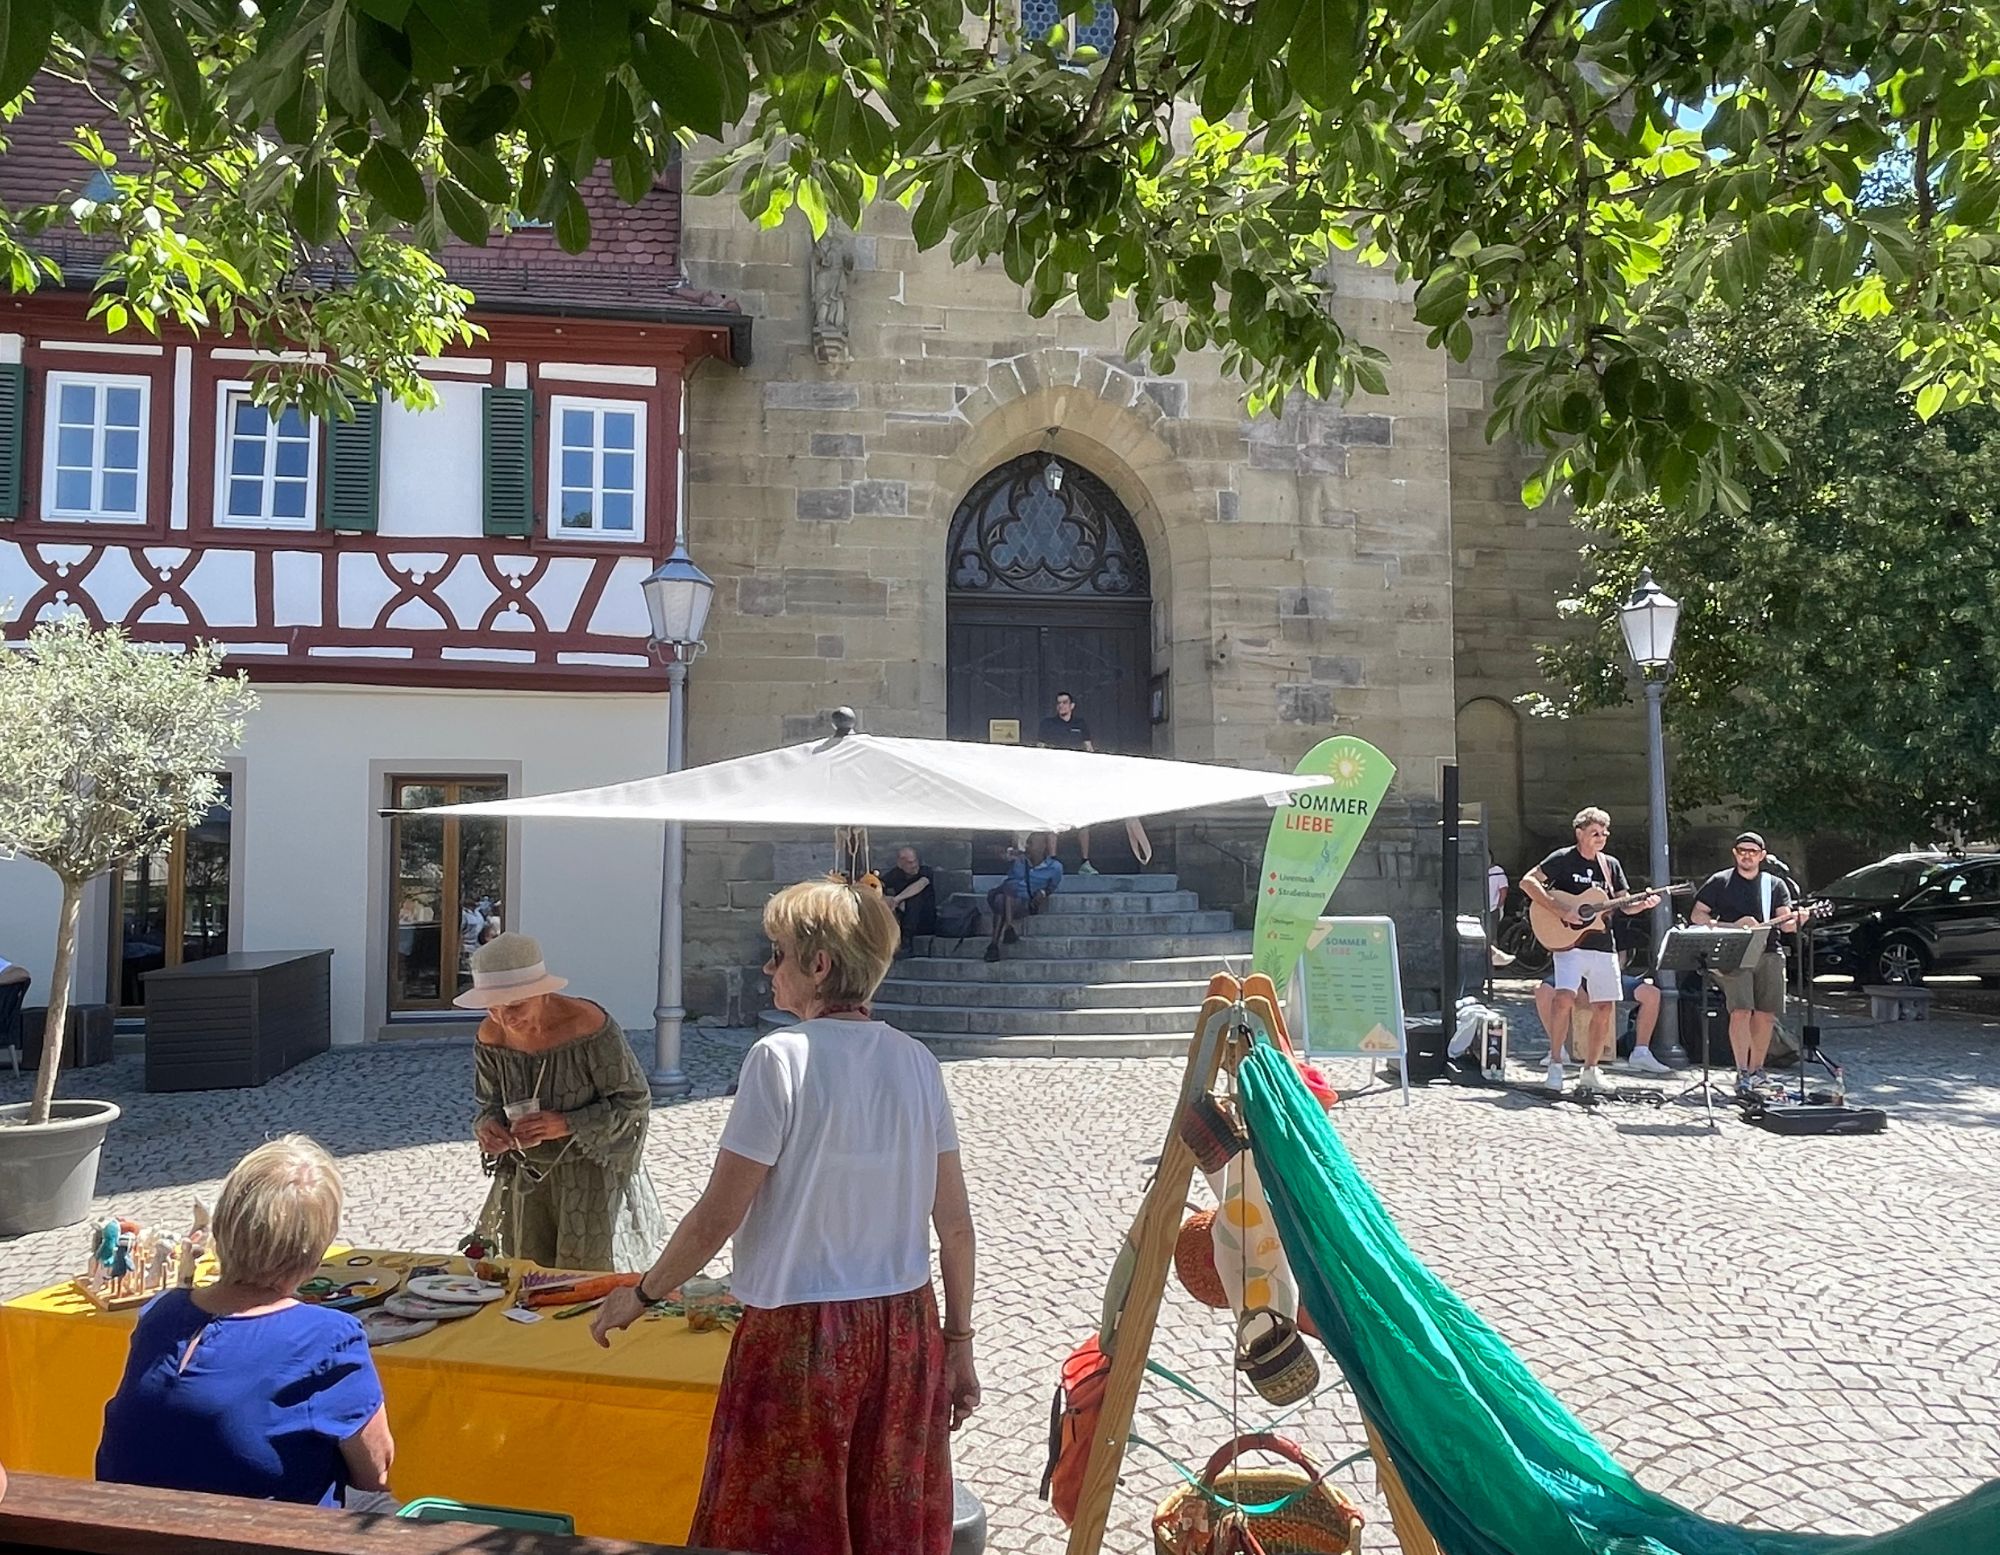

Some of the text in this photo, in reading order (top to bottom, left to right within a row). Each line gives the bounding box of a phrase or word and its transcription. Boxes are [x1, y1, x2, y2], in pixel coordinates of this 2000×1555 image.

[1287, 792, 1368, 816] SOMMER
[1285, 814, 1334, 834] LIEBE
[1279, 873, 1315, 883] Livemusik
[1278, 887, 1326, 899] Straßenkunst
[1326, 937, 1367, 947] SOMMER
